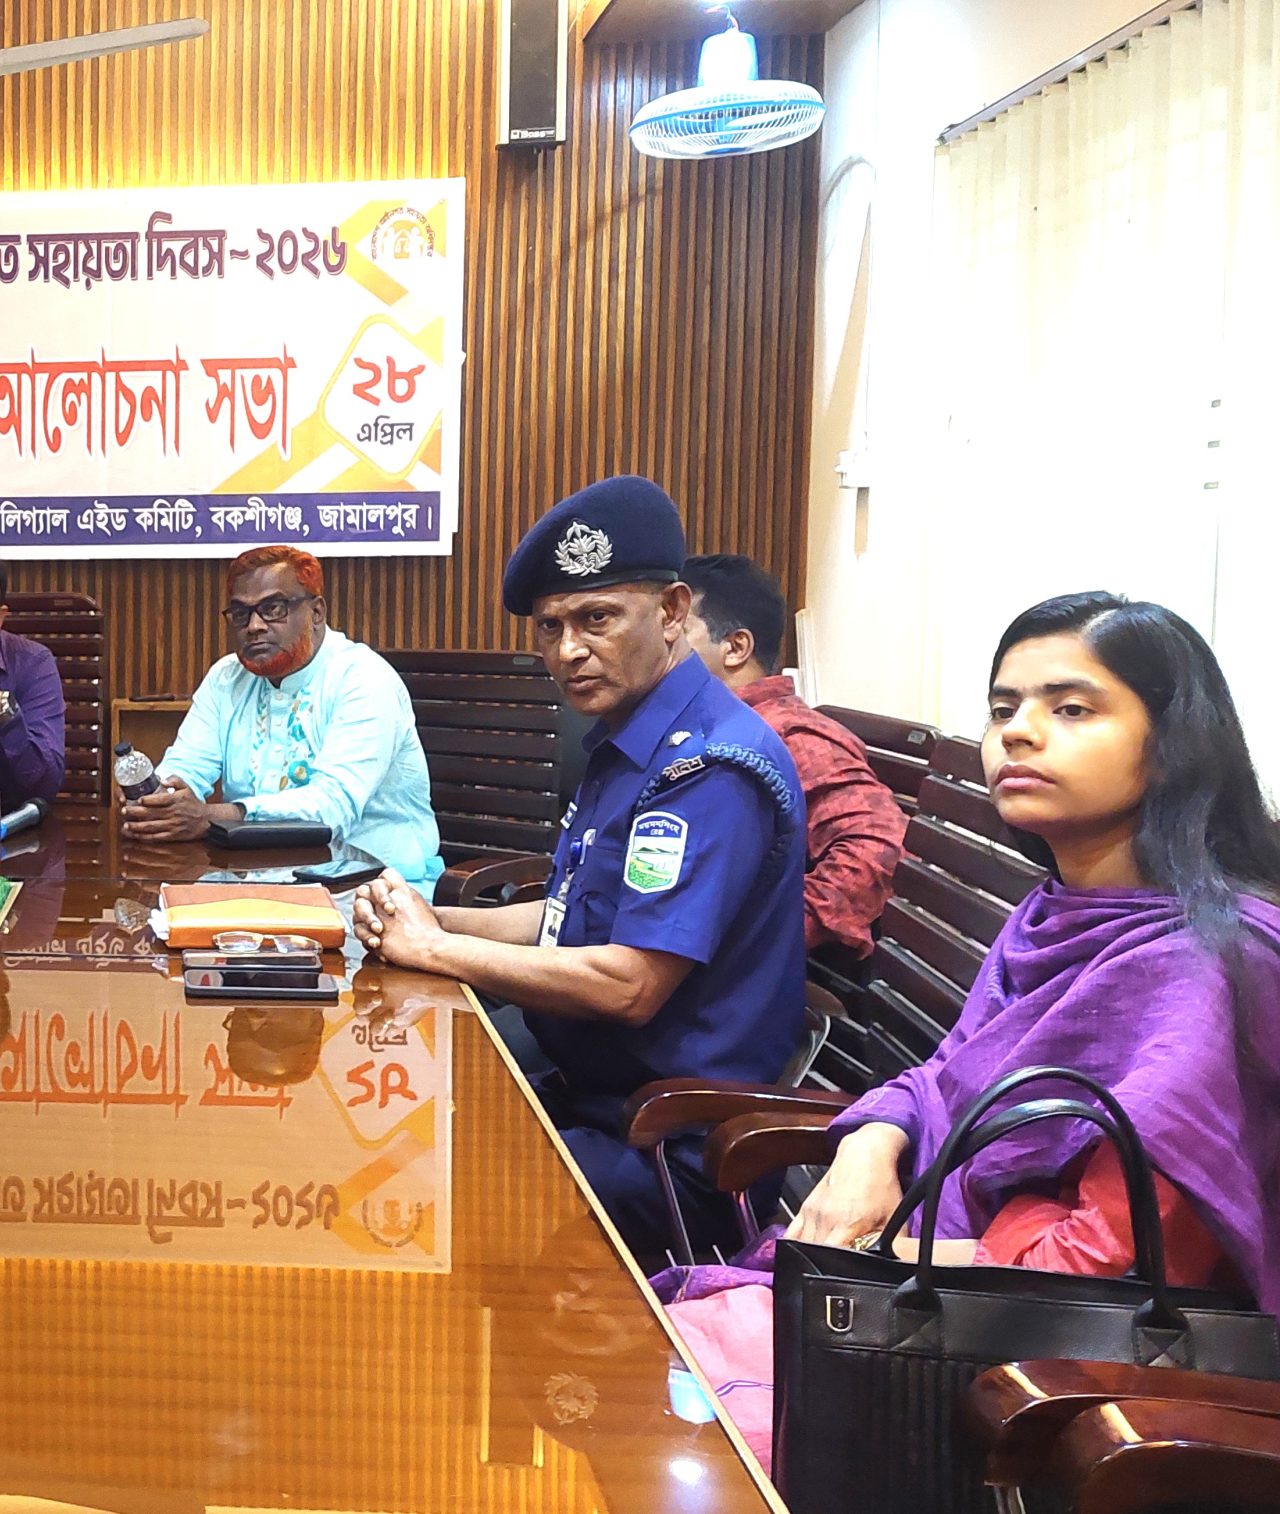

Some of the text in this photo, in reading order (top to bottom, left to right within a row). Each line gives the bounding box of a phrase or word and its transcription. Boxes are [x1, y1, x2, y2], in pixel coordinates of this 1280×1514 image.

[27, 230, 139, 290] সহায়তা
[200, 345, 297, 456] সভা
[353, 356, 425, 406] ২৮
[356, 415, 414, 445] এপ্রিল
[77, 500, 128, 536] এইড
[133, 499, 202, 537] কমিটি,
[209, 497, 309, 537] বকশীগঞ্জ,
